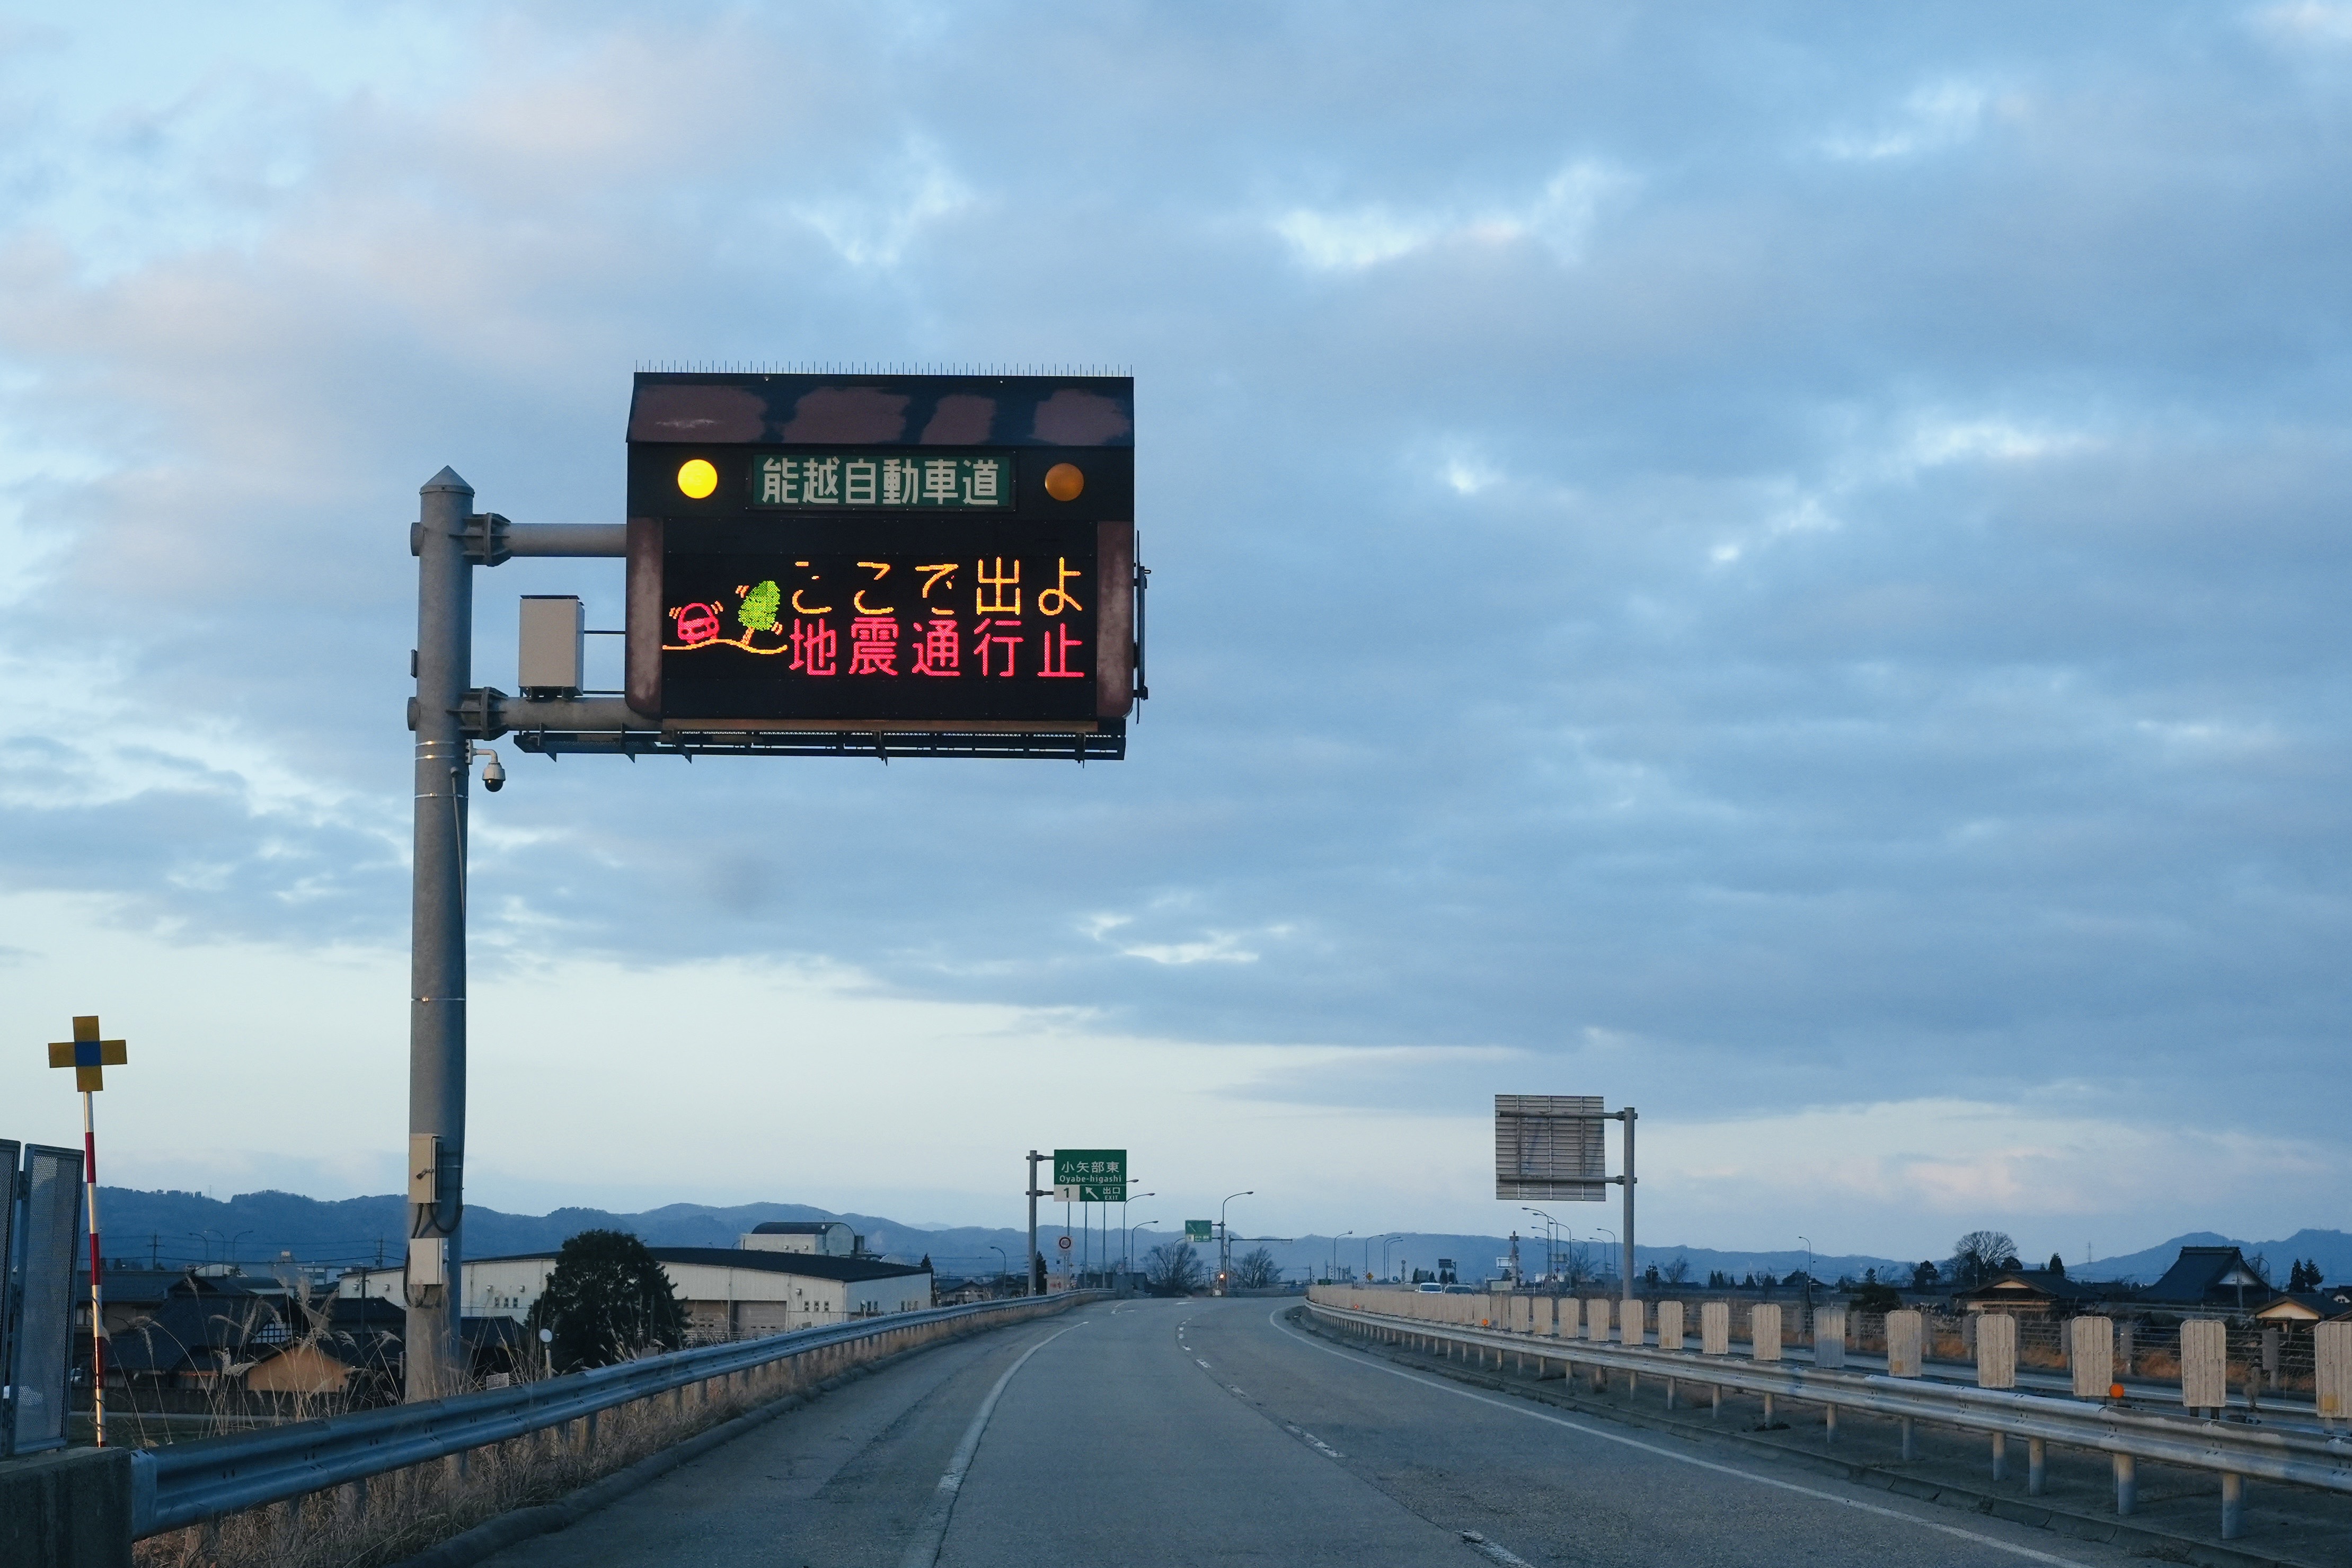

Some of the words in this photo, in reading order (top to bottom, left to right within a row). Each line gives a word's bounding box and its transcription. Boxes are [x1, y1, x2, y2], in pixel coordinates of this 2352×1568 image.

[762, 457, 999, 505] 能越自動車道
[792, 557, 1082, 615] ここで出よ
[789, 617, 1085, 676] 地震通行止
[1059, 1175, 1121, 1184] Oyabe-higashi
[1061, 1161, 1120, 1173] 小矢部東
[1064, 1188, 1069, 1198] 1
